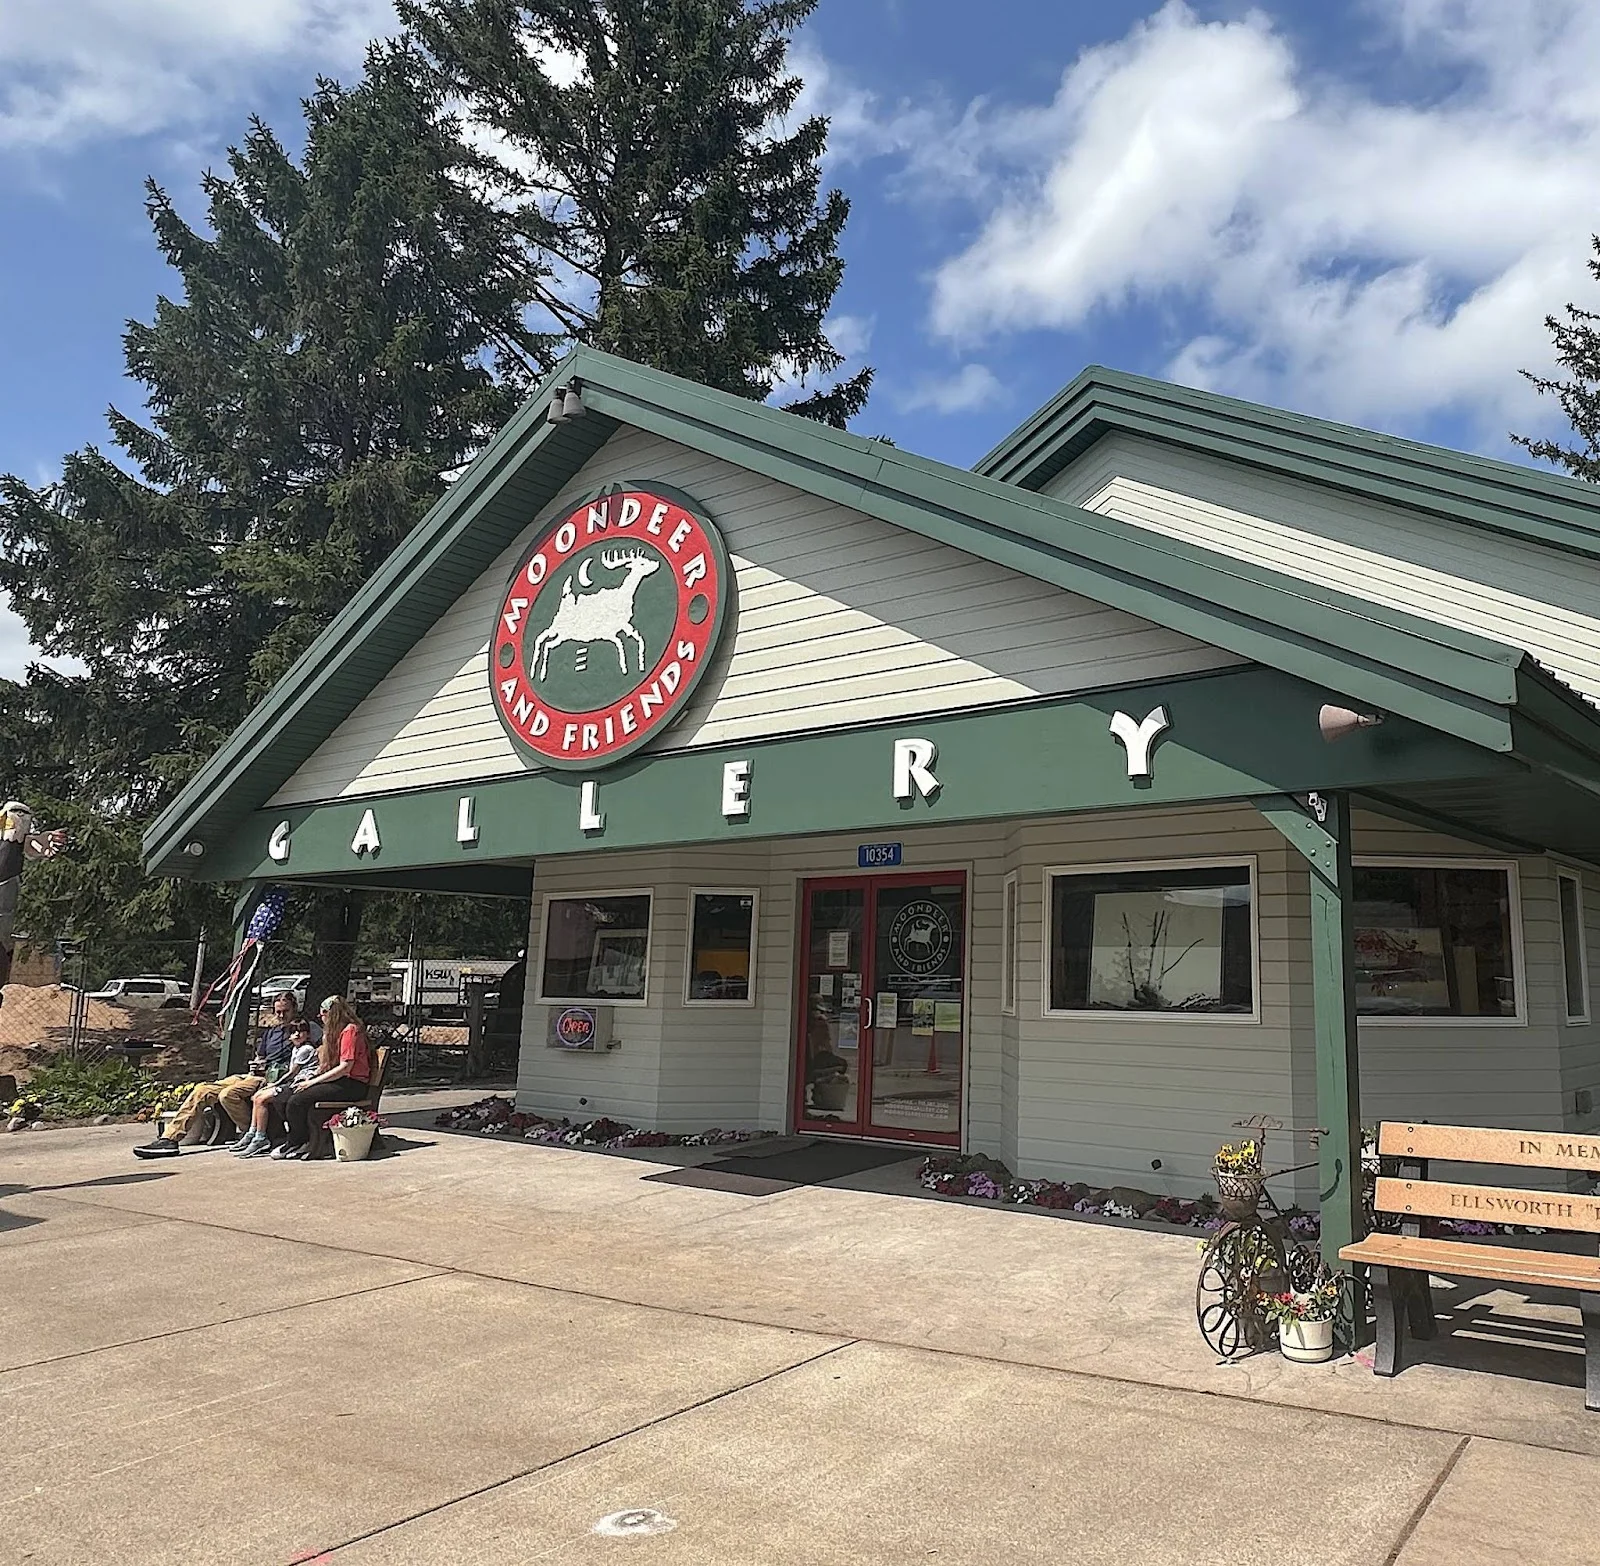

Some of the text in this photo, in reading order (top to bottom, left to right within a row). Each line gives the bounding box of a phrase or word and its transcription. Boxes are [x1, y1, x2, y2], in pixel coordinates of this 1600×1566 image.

[502, 497, 707, 635] MOONDEER
[500, 640, 696, 752] AND FRIENDS
[267, 704, 1171, 861] GALLERY
[865, 847, 895, 863] 10354
[893, 903, 949, 934] MOONDEER
[893, 948, 948, 973] AND FRIENDS
[1518, 1140, 1542, 1154] IN
[1450, 1194, 1573, 1218] ELLSWORTH
